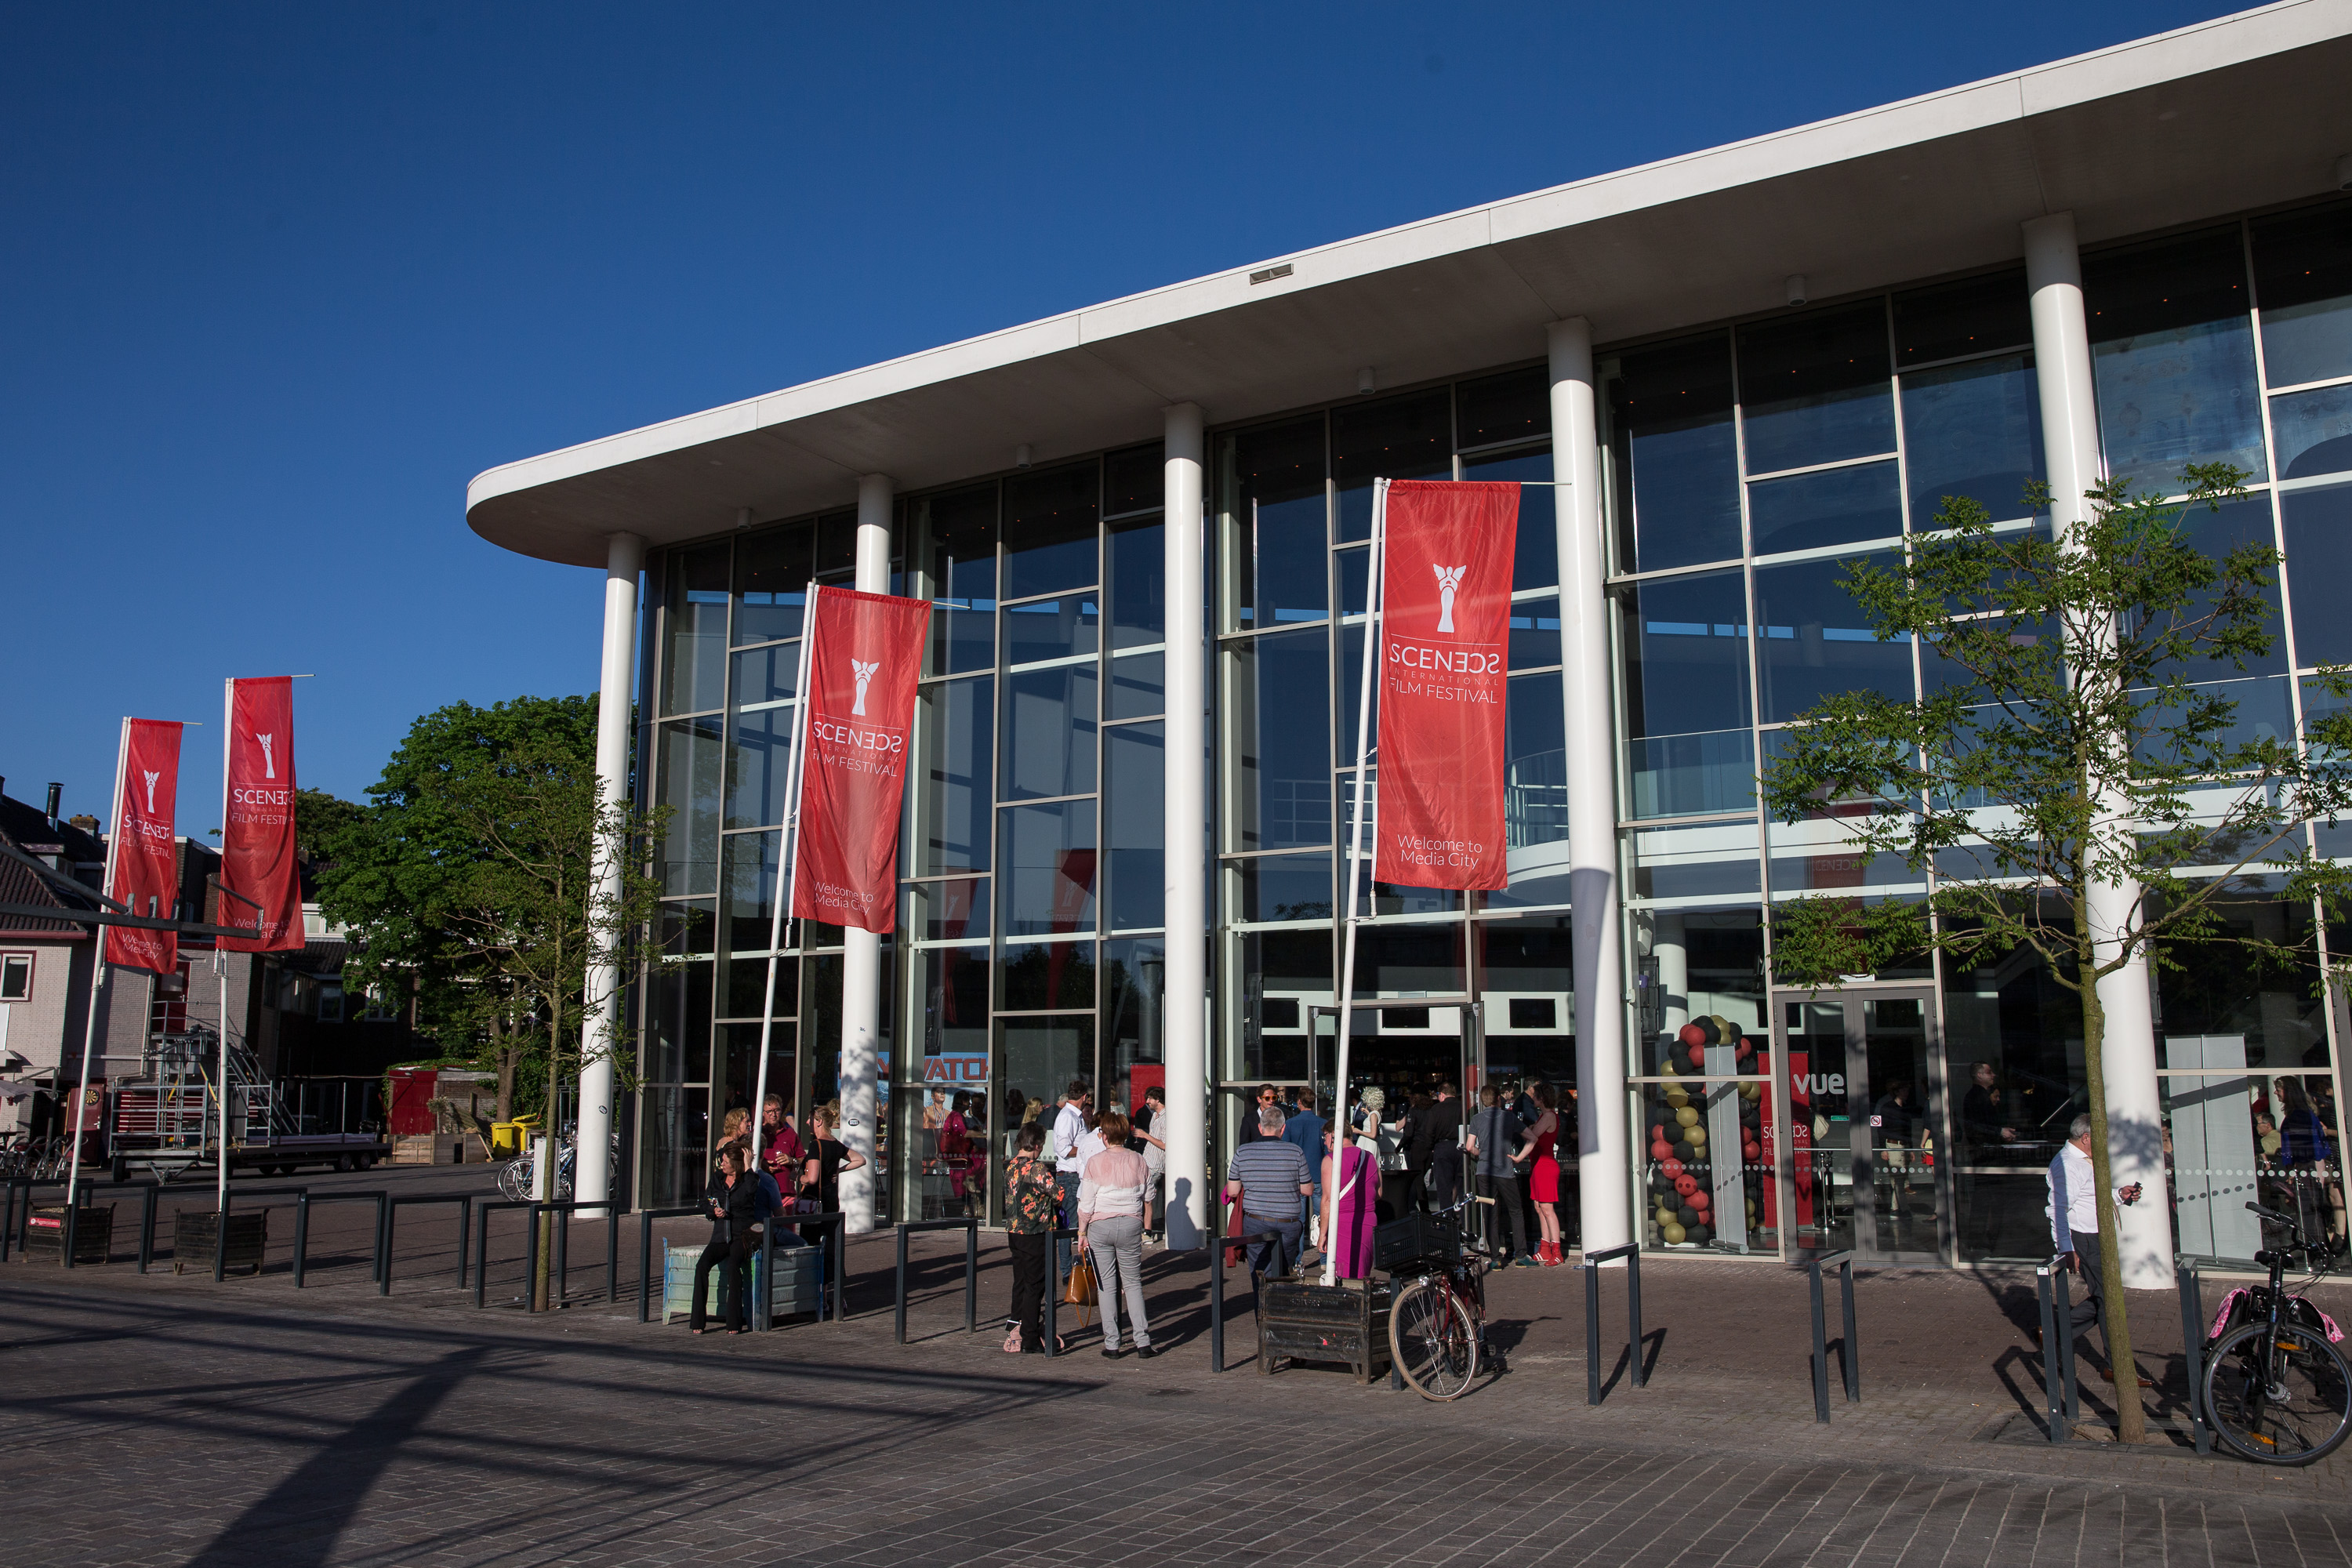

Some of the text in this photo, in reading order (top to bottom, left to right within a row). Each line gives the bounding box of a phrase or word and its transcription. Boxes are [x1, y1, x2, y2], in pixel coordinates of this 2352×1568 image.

[1388, 666, 1498, 686] INTERNATIONAL
[1389, 677, 1498, 704] FILM FESTIVAL
[839, 757, 897, 777] FESTIVAL
[231, 812, 258, 824] FILM
[1397, 834, 1483, 854] Welcome to
[1401, 849, 1479, 870] Media City
[814, 880, 874, 902] Welcome to
[815, 893, 870, 916] Media City
[269, 929, 289, 938] City
[152, 942, 163, 950] to
[1793, 1073, 1845, 1094] vue
